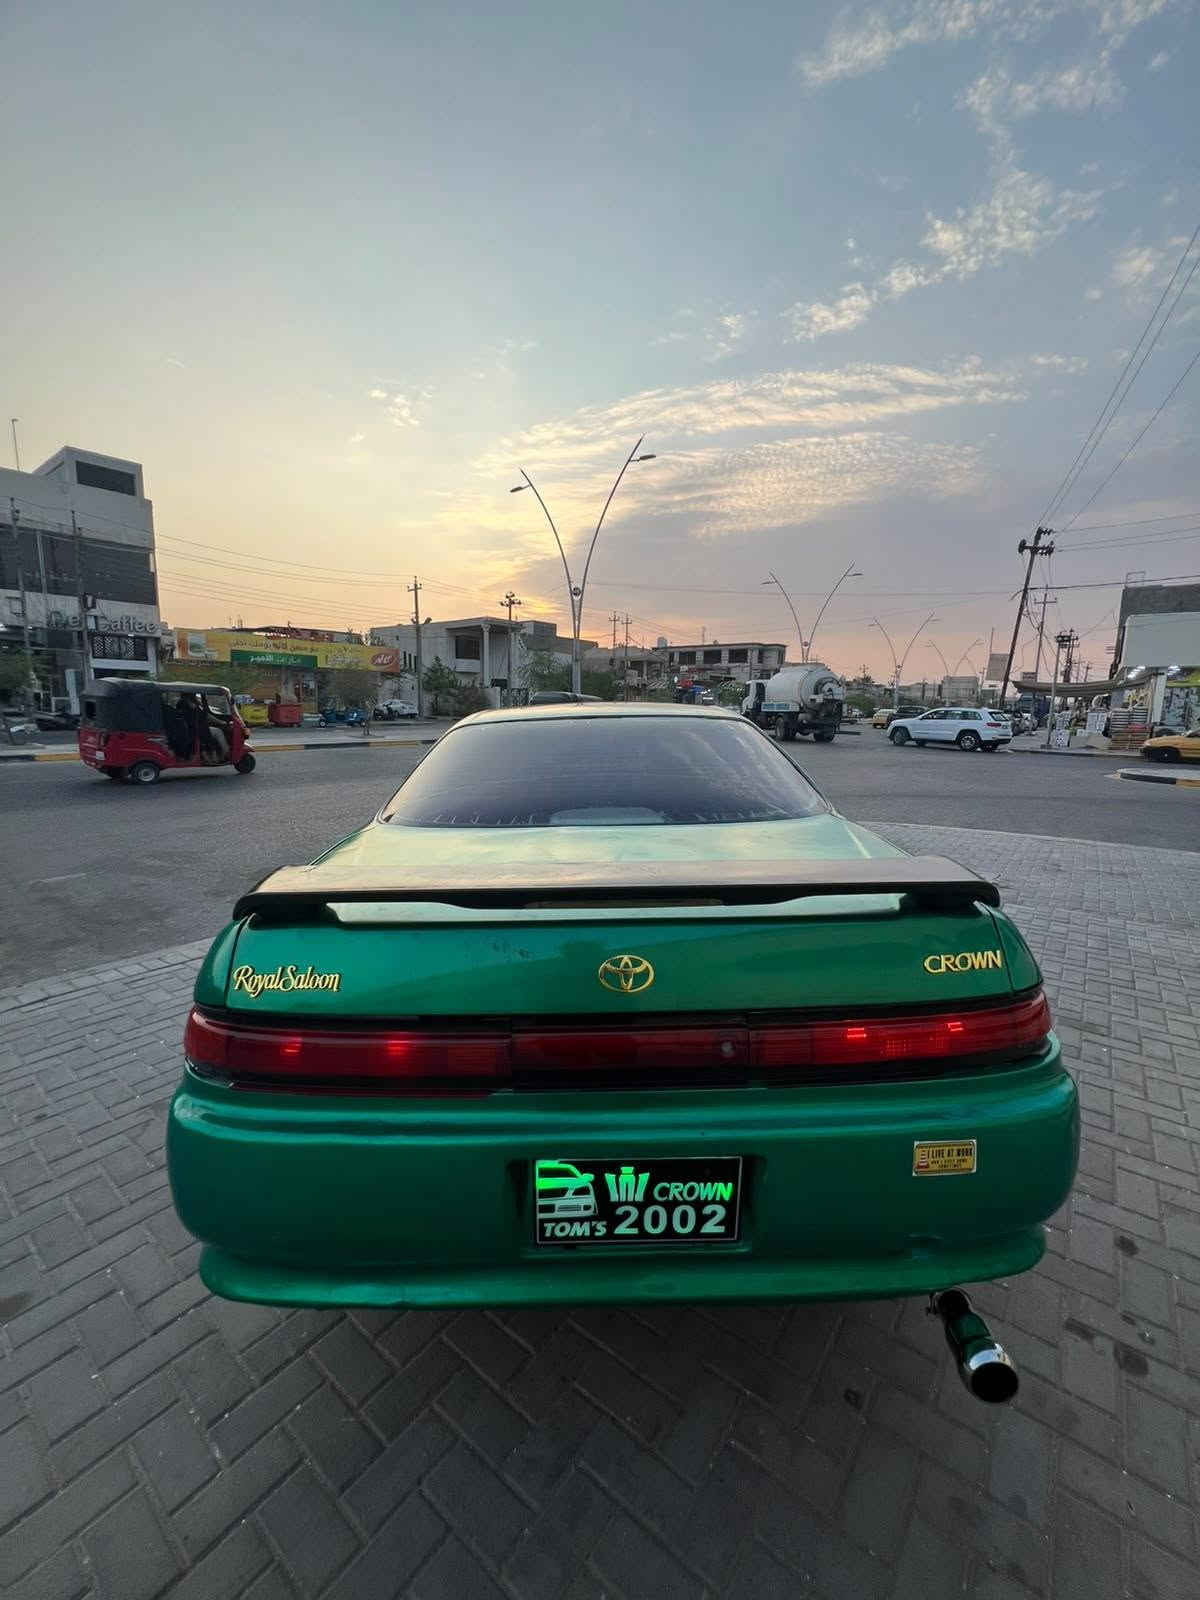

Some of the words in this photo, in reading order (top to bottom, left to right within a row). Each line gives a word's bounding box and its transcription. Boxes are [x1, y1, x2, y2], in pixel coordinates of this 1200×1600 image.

[924, 950, 1002, 973] CROWN
[653, 1182, 732, 1201] CROWN
[544, 1221, 607, 1236] TOM'S
[614, 1205, 726, 1234] 2002
